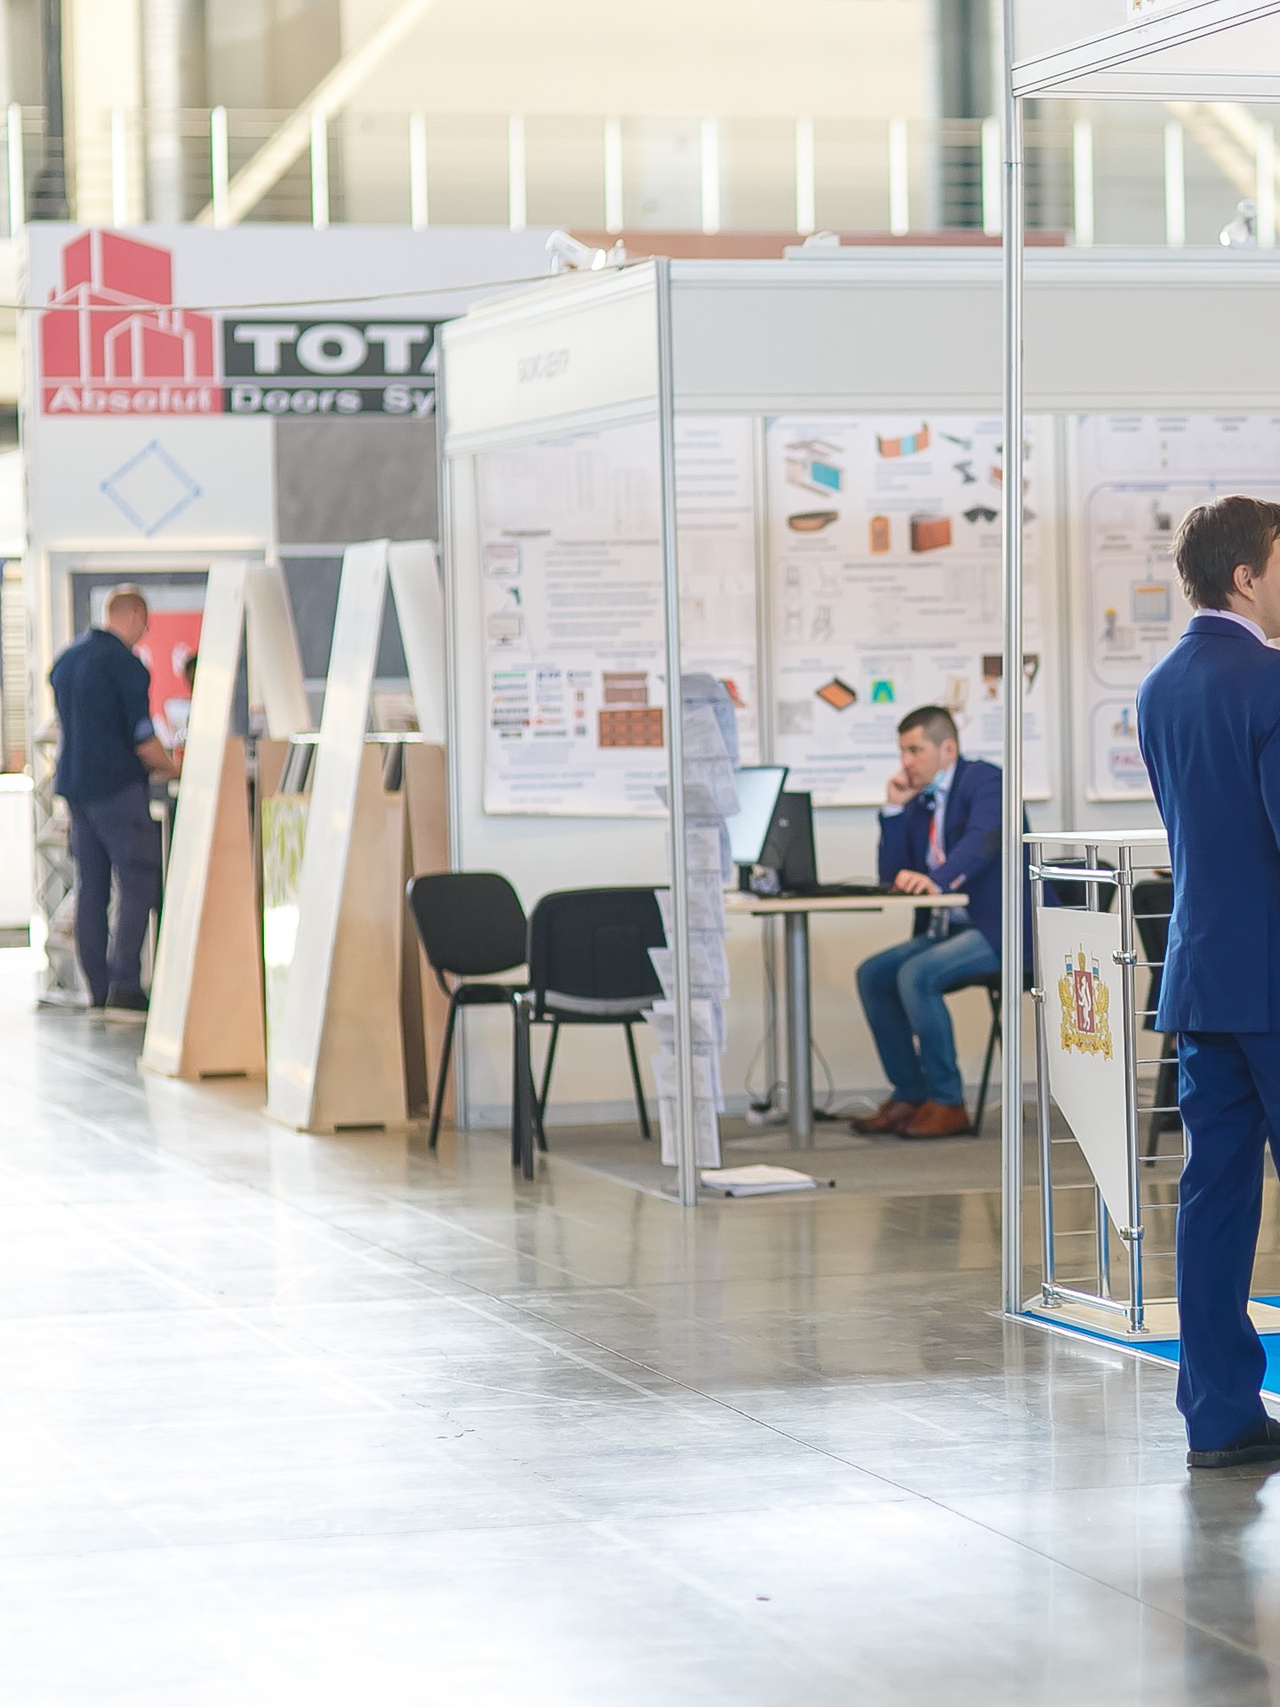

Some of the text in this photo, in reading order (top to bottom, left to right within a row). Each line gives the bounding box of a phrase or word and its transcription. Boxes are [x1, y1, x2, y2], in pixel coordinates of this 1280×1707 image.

[233, 323, 435, 374] TOT
[50, 384, 211, 413] Absolut
[231, 384, 364, 414] Doors
